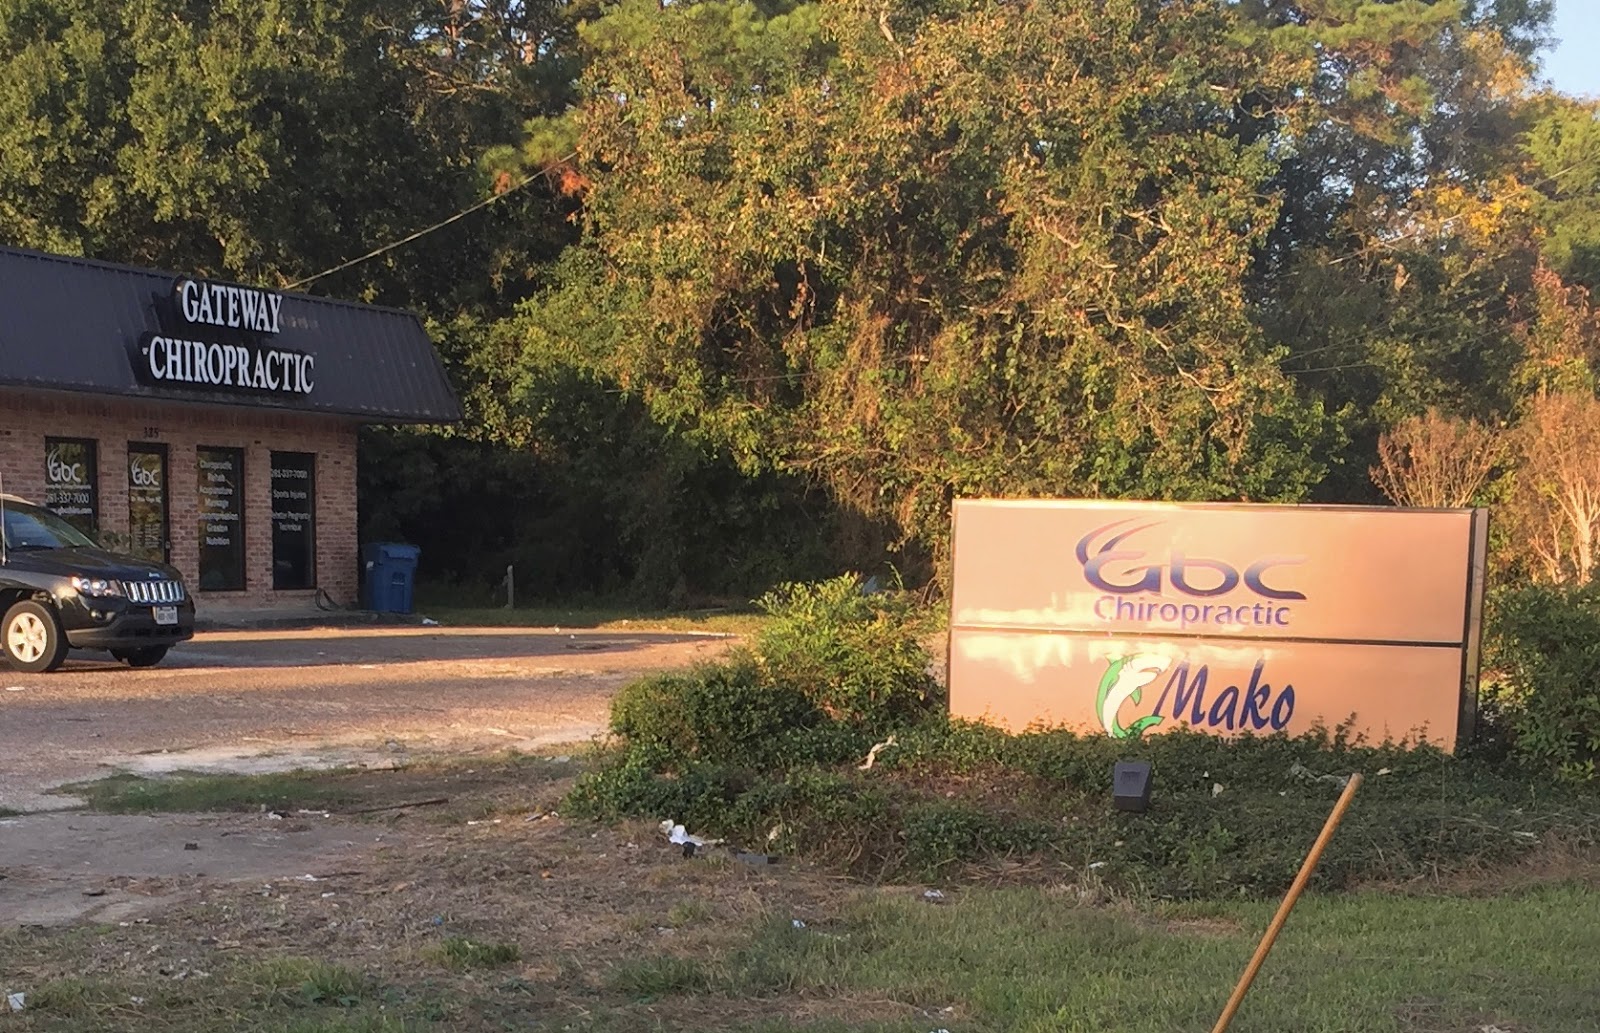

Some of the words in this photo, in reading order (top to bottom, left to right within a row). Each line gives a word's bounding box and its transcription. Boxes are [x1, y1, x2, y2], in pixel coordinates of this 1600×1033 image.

[182, 280, 282, 333] GATEWAY
[150, 336, 314, 394] CHIROPRACTIC
[1094, 596, 1290, 629] Chiropractic
[1151, 656, 1295, 731] Mako
